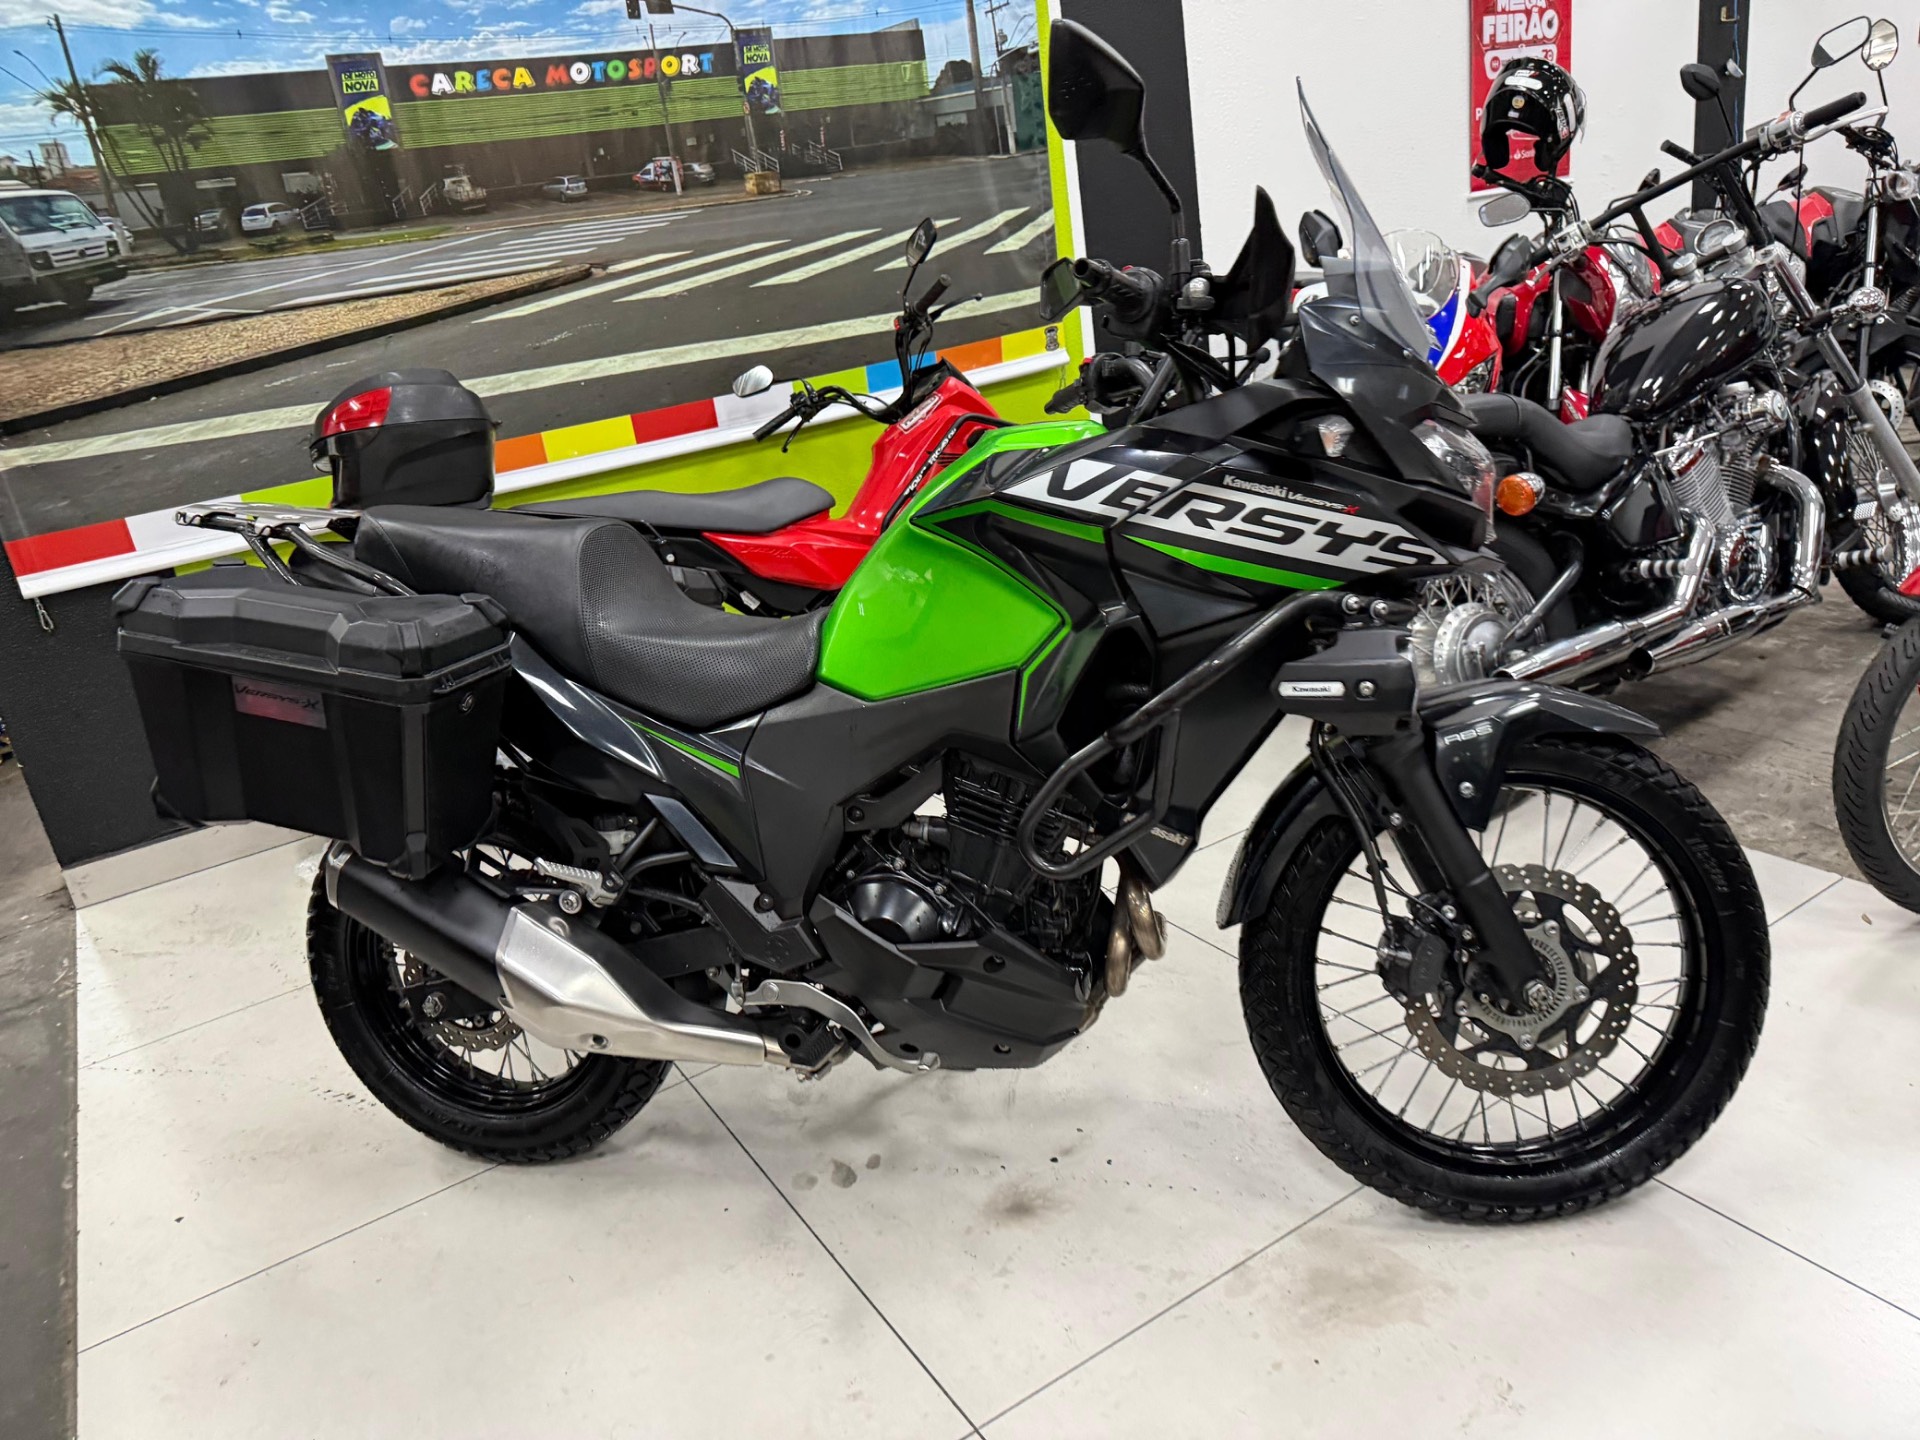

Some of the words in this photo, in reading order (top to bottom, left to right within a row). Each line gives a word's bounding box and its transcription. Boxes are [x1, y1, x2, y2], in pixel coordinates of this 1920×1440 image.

[1482, 7, 1559, 45] FEIRÃO
[745, 53, 769, 63] NOVA
[344, 80, 377, 92] NOVA
[409, 66, 536, 97] CARECA
[545, 52, 714, 86] MOTOSPORT
[1222, 474, 1287, 497] Kawasaki
[1044, 459, 1437, 567] VERSYS
[1443, 721, 1494, 746] ABS
[1150, 826, 1189, 846] asaki
